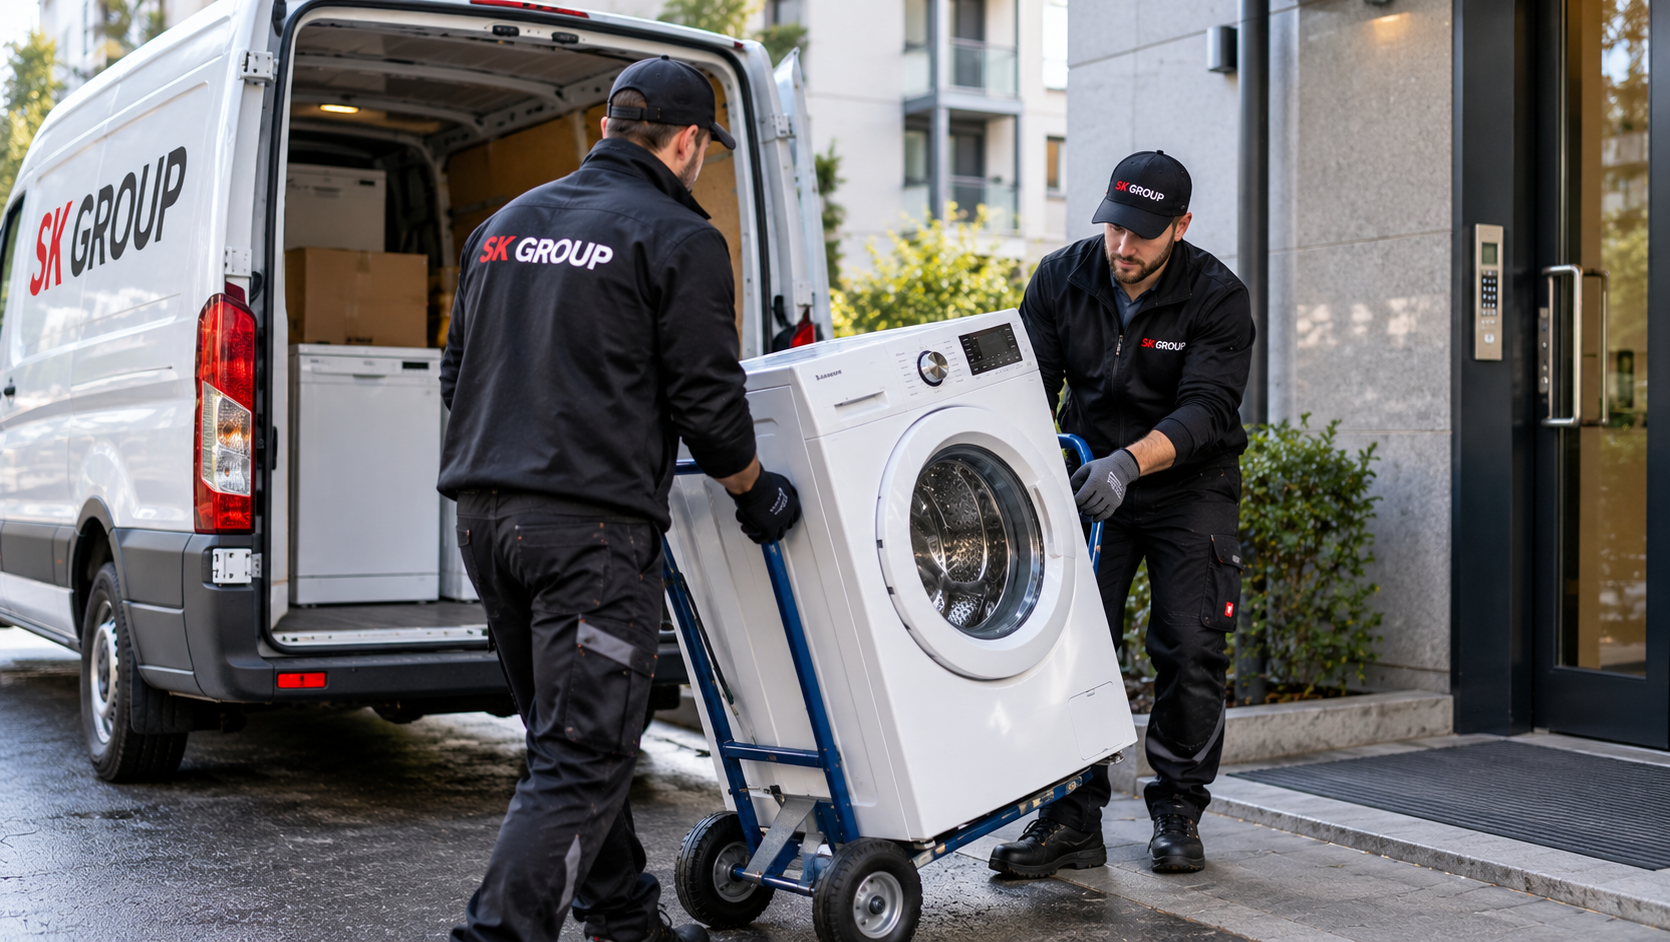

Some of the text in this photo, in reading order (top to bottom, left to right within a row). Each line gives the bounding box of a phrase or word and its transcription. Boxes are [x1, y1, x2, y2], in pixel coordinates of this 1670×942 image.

[1115, 181, 1165, 201] SK GROUP
[30, 146, 187, 296] SK GROUP
[479, 235, 614, 270] SK GROUP
[1141, 338, 1186, 351] SK GROUP
